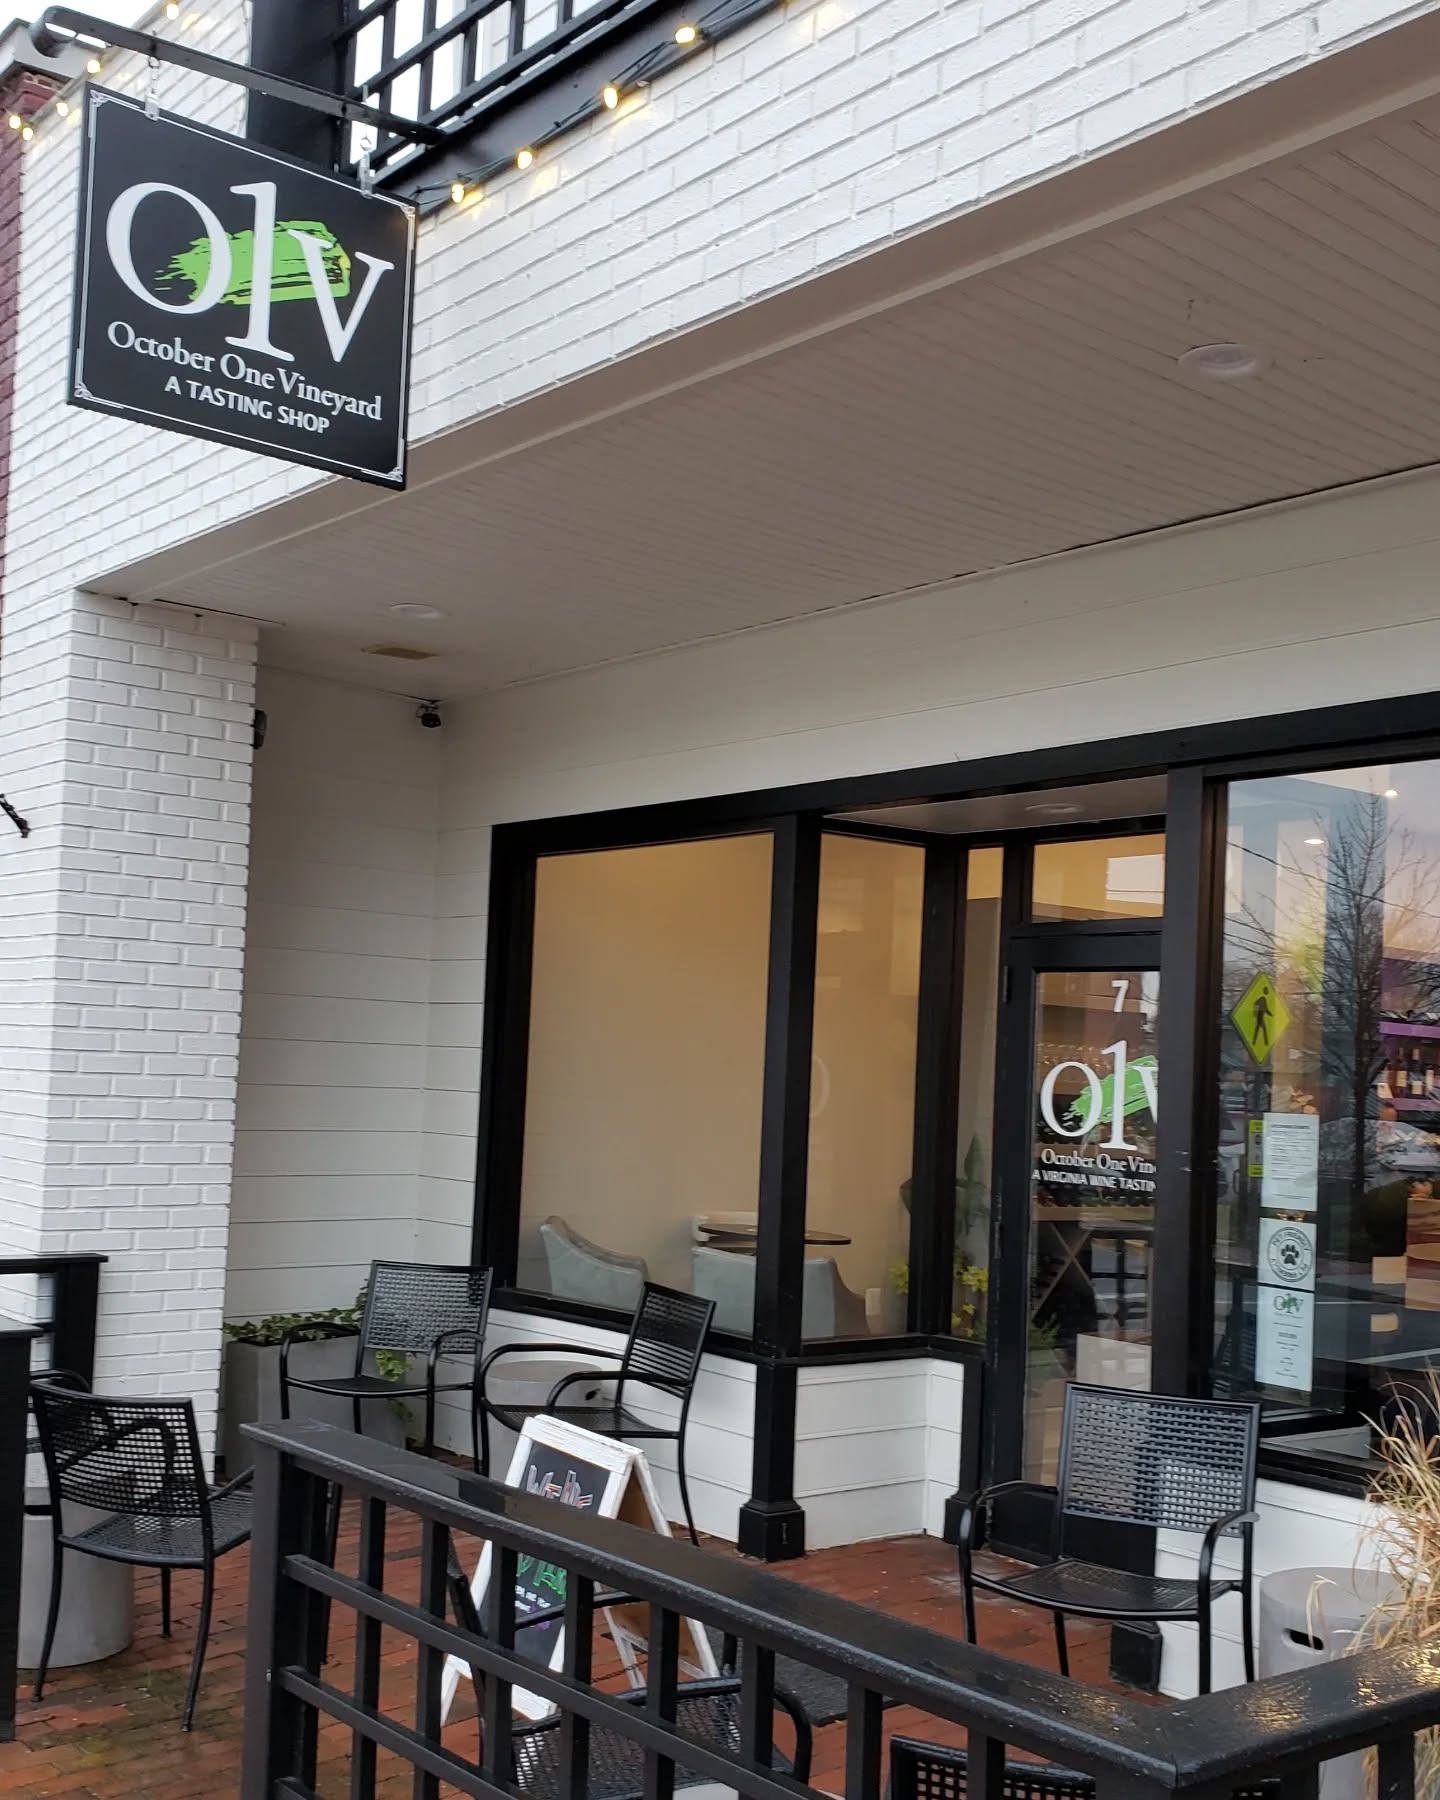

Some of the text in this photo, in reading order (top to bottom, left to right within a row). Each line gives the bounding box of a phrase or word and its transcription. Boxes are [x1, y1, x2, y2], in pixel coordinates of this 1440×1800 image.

[107, 320, 383, 421] October One Vineyard
[164, 375, 331, 434] A TASTING SHOP
[1111, 979, 1129, 1013] 7
[1041, 1148, 1095, 1168] October
[1097, 1153, 1128, 1171] One
